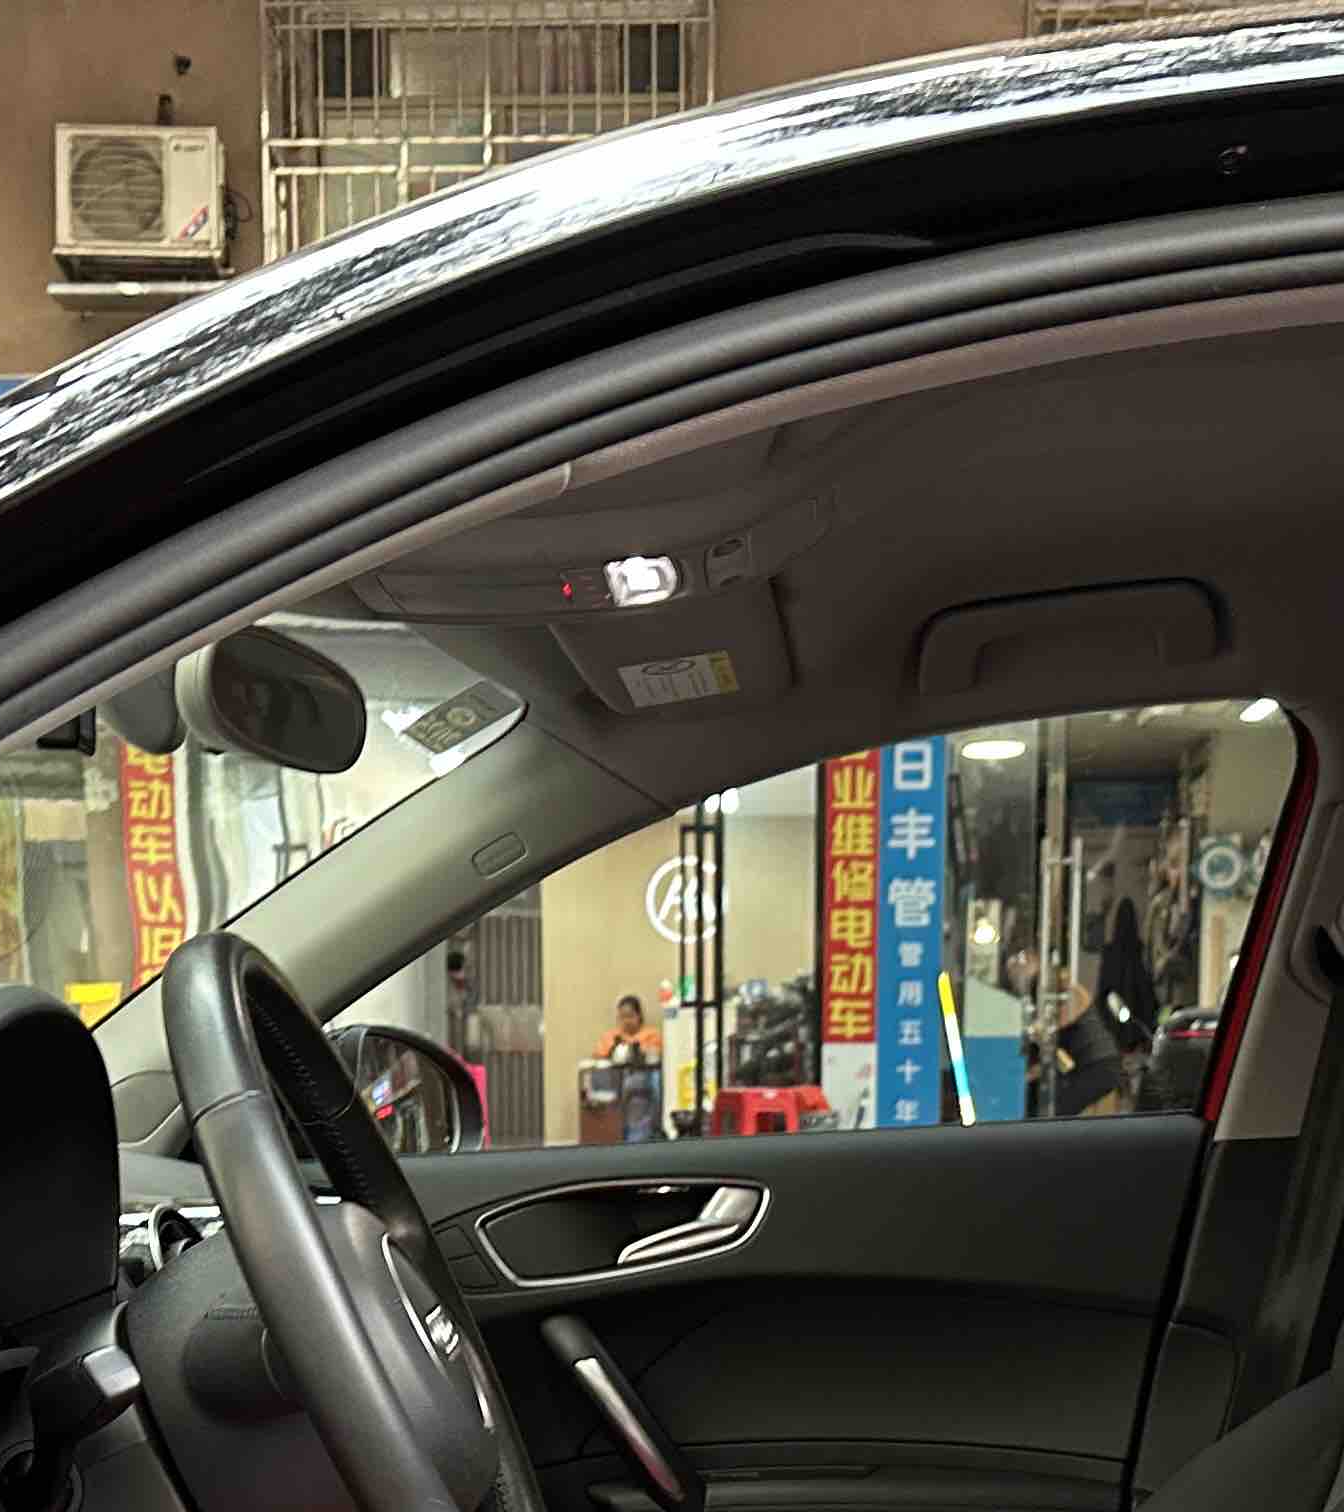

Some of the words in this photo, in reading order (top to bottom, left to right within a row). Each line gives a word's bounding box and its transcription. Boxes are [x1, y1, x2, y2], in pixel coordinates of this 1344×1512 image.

[127, 743, 184, 984] 电动车以旧
[830, 751, 876, 1039] 业维修电动车
[887, 740, 937, 928] 日丰管
